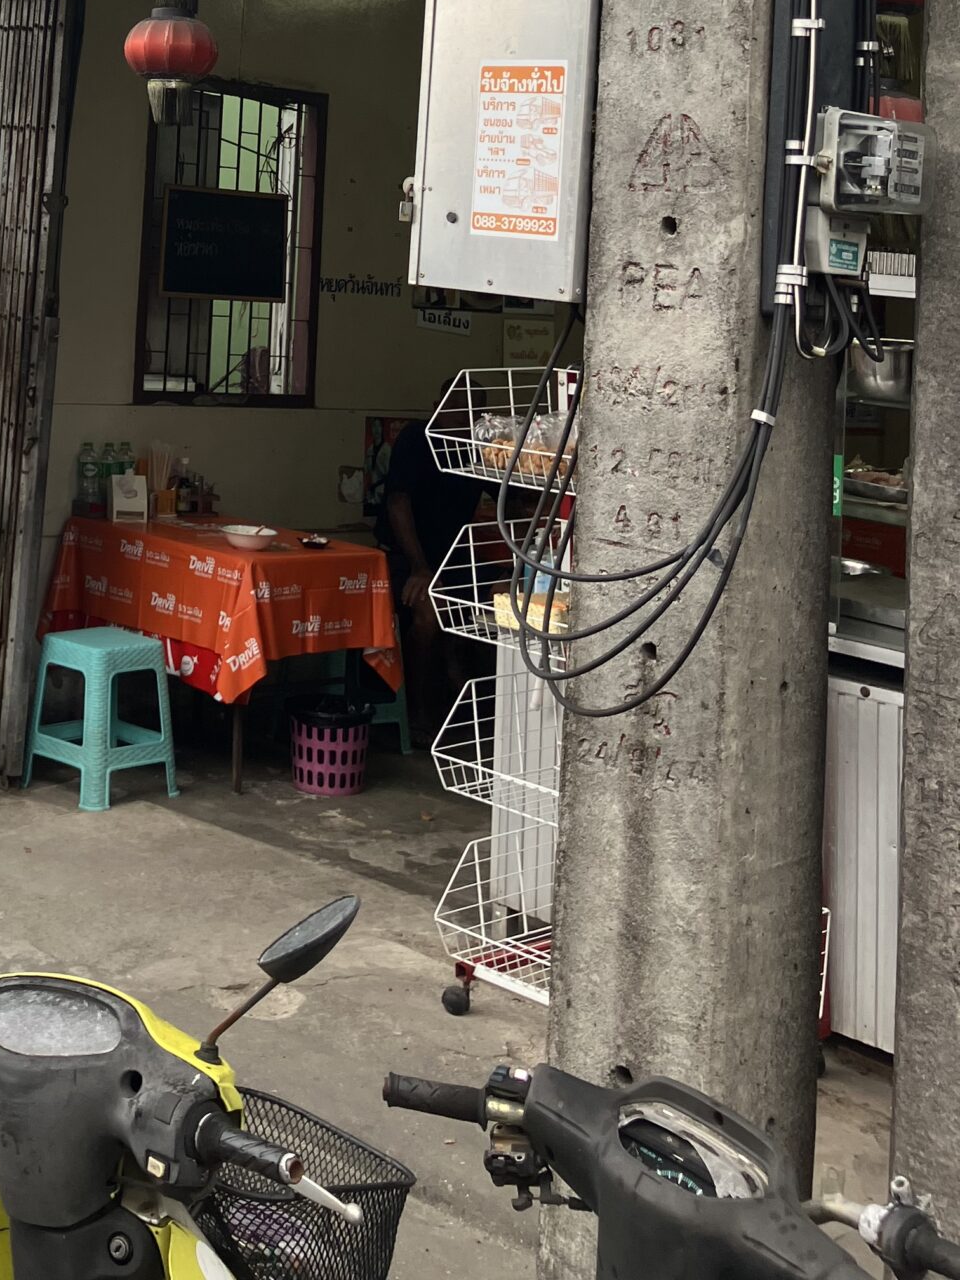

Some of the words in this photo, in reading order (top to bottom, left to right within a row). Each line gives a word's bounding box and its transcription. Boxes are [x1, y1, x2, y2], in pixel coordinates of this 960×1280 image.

[481, 67, 563, 93] รับจ้างทั่วไป
[483, 96, 516, 112] บริการ
[476, 166, 506, 179] บริการ
[474, 215, 554, 233] 088-3799923
[189, 554, 215, 575] DRIVE
[151, 591, 176, 610] DRIVE
[225, 643, 260, 673] DRIVE
